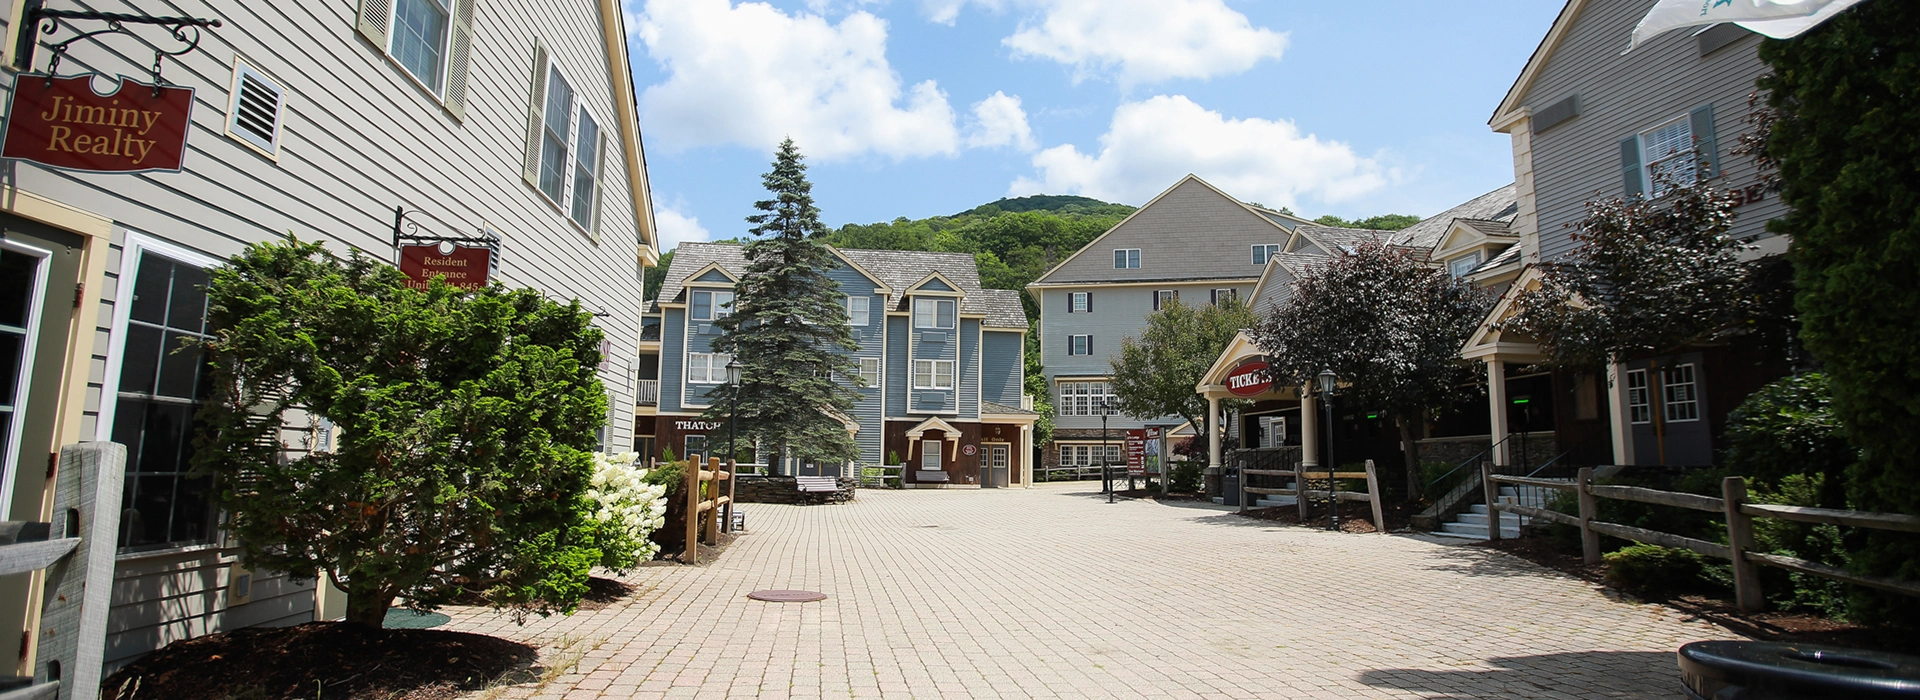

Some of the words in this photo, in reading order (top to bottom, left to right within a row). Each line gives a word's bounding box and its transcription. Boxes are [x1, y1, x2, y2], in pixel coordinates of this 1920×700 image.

[41, 96, 162, 136] Jiminy
[46, 125, 156, 165] Realty
[421, 268, 467, 279] Entance
[423, 256, 467, 267] Resident
